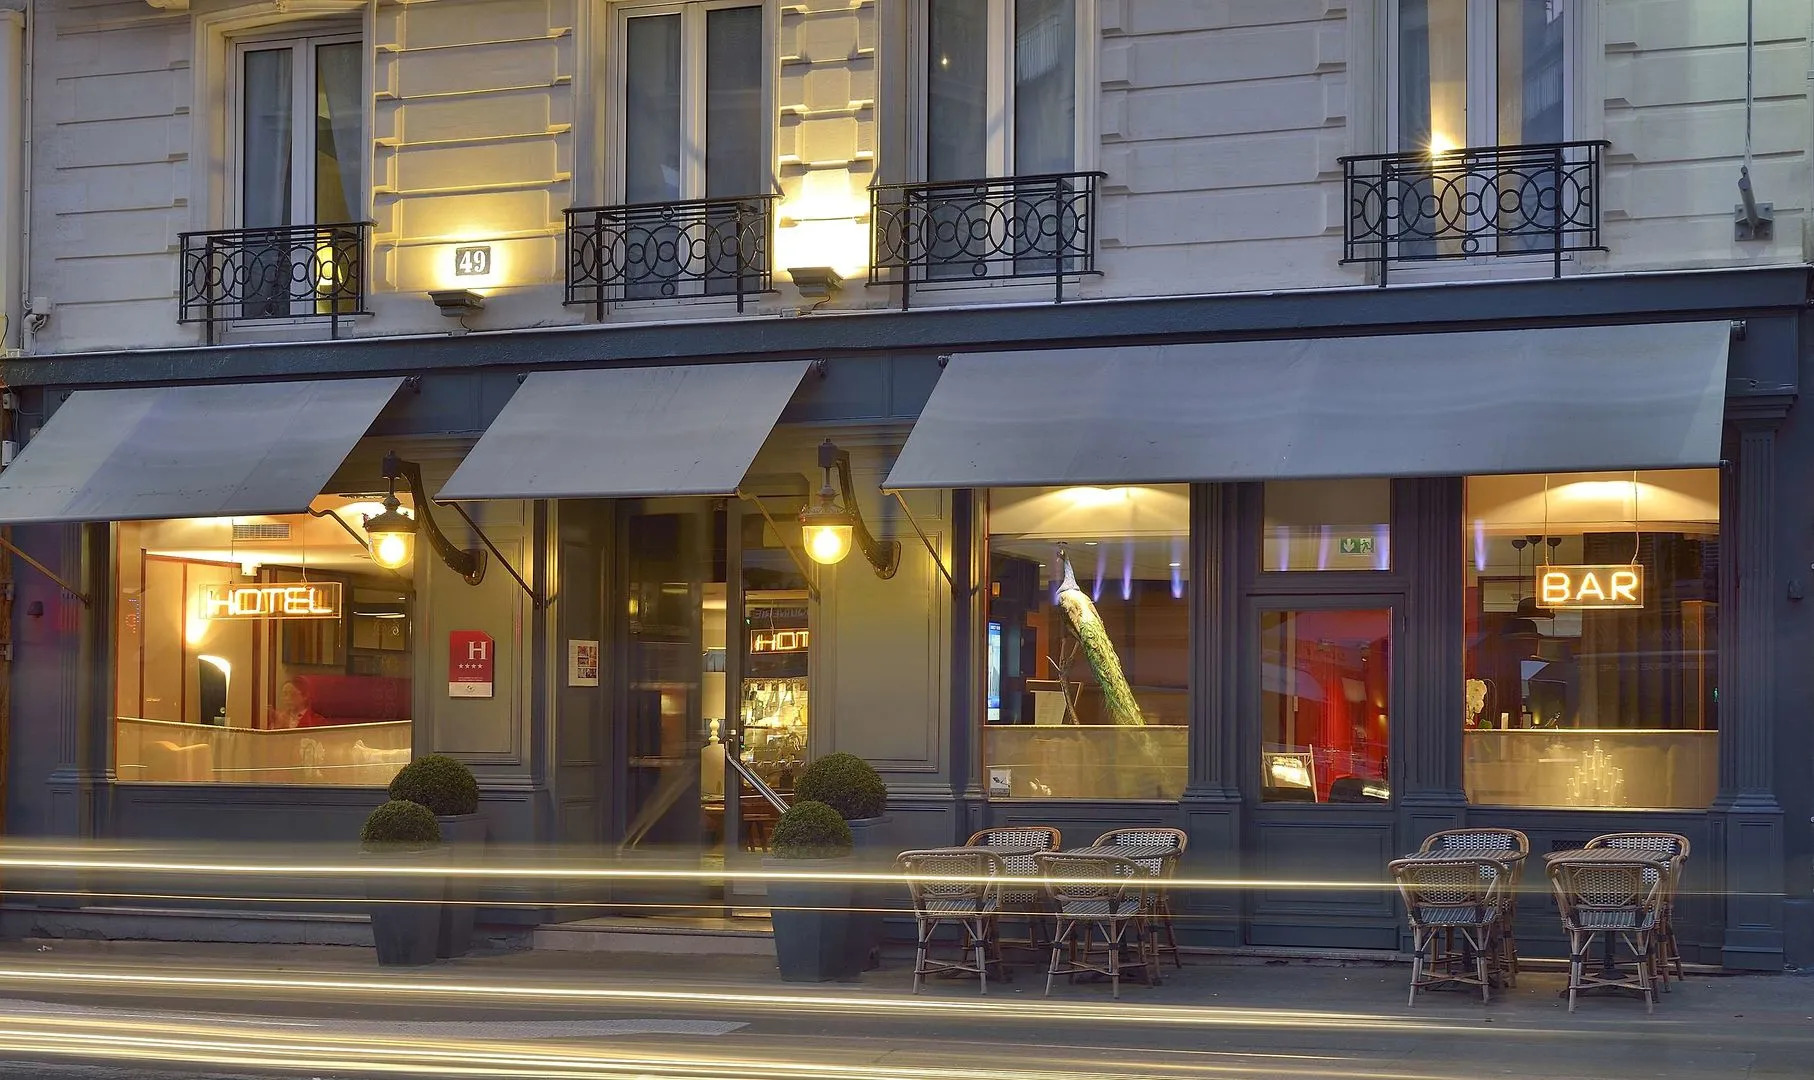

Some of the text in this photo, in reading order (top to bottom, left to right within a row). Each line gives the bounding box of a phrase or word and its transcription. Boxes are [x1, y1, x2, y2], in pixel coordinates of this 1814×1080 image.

[459, 250, 486, 272] 49
[1543, 571, 1637, 602] BAR
[207, 587, 333, 615] HOTEL
[468, 641, 487, 660] H
